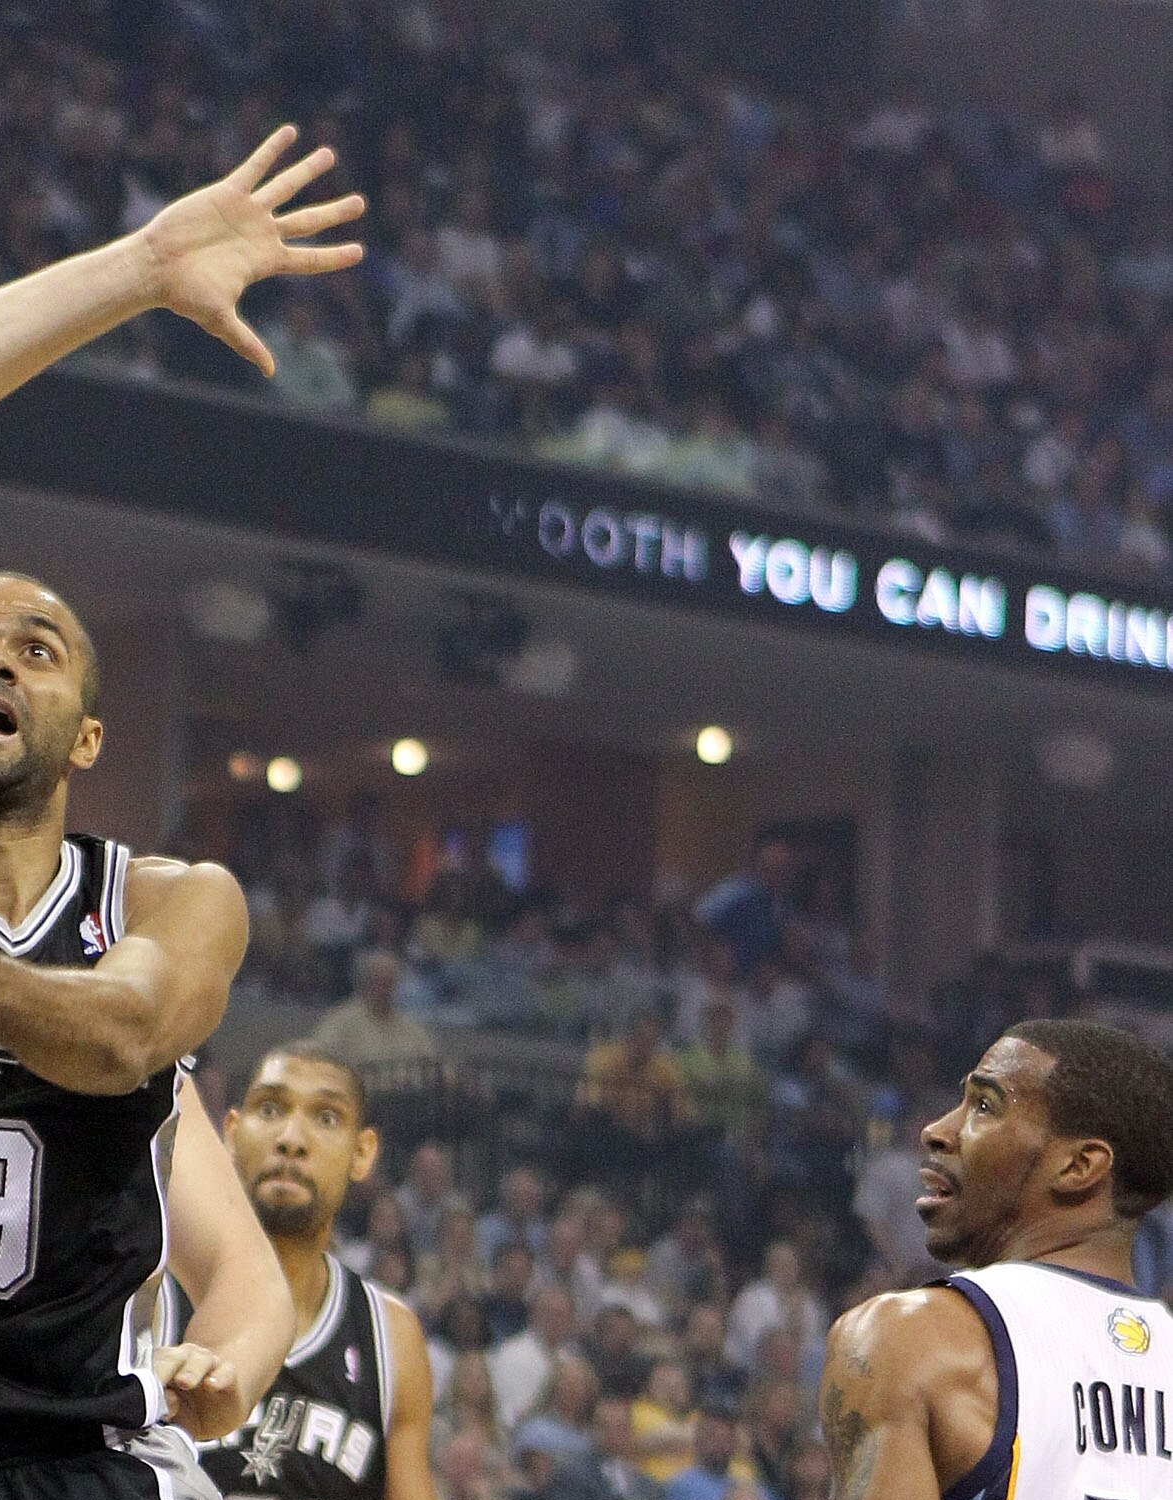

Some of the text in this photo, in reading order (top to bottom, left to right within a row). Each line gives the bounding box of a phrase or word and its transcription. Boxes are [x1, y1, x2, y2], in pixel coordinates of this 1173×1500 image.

[489, 498, 1173, 671] OOTH YOU CAN DRIN
